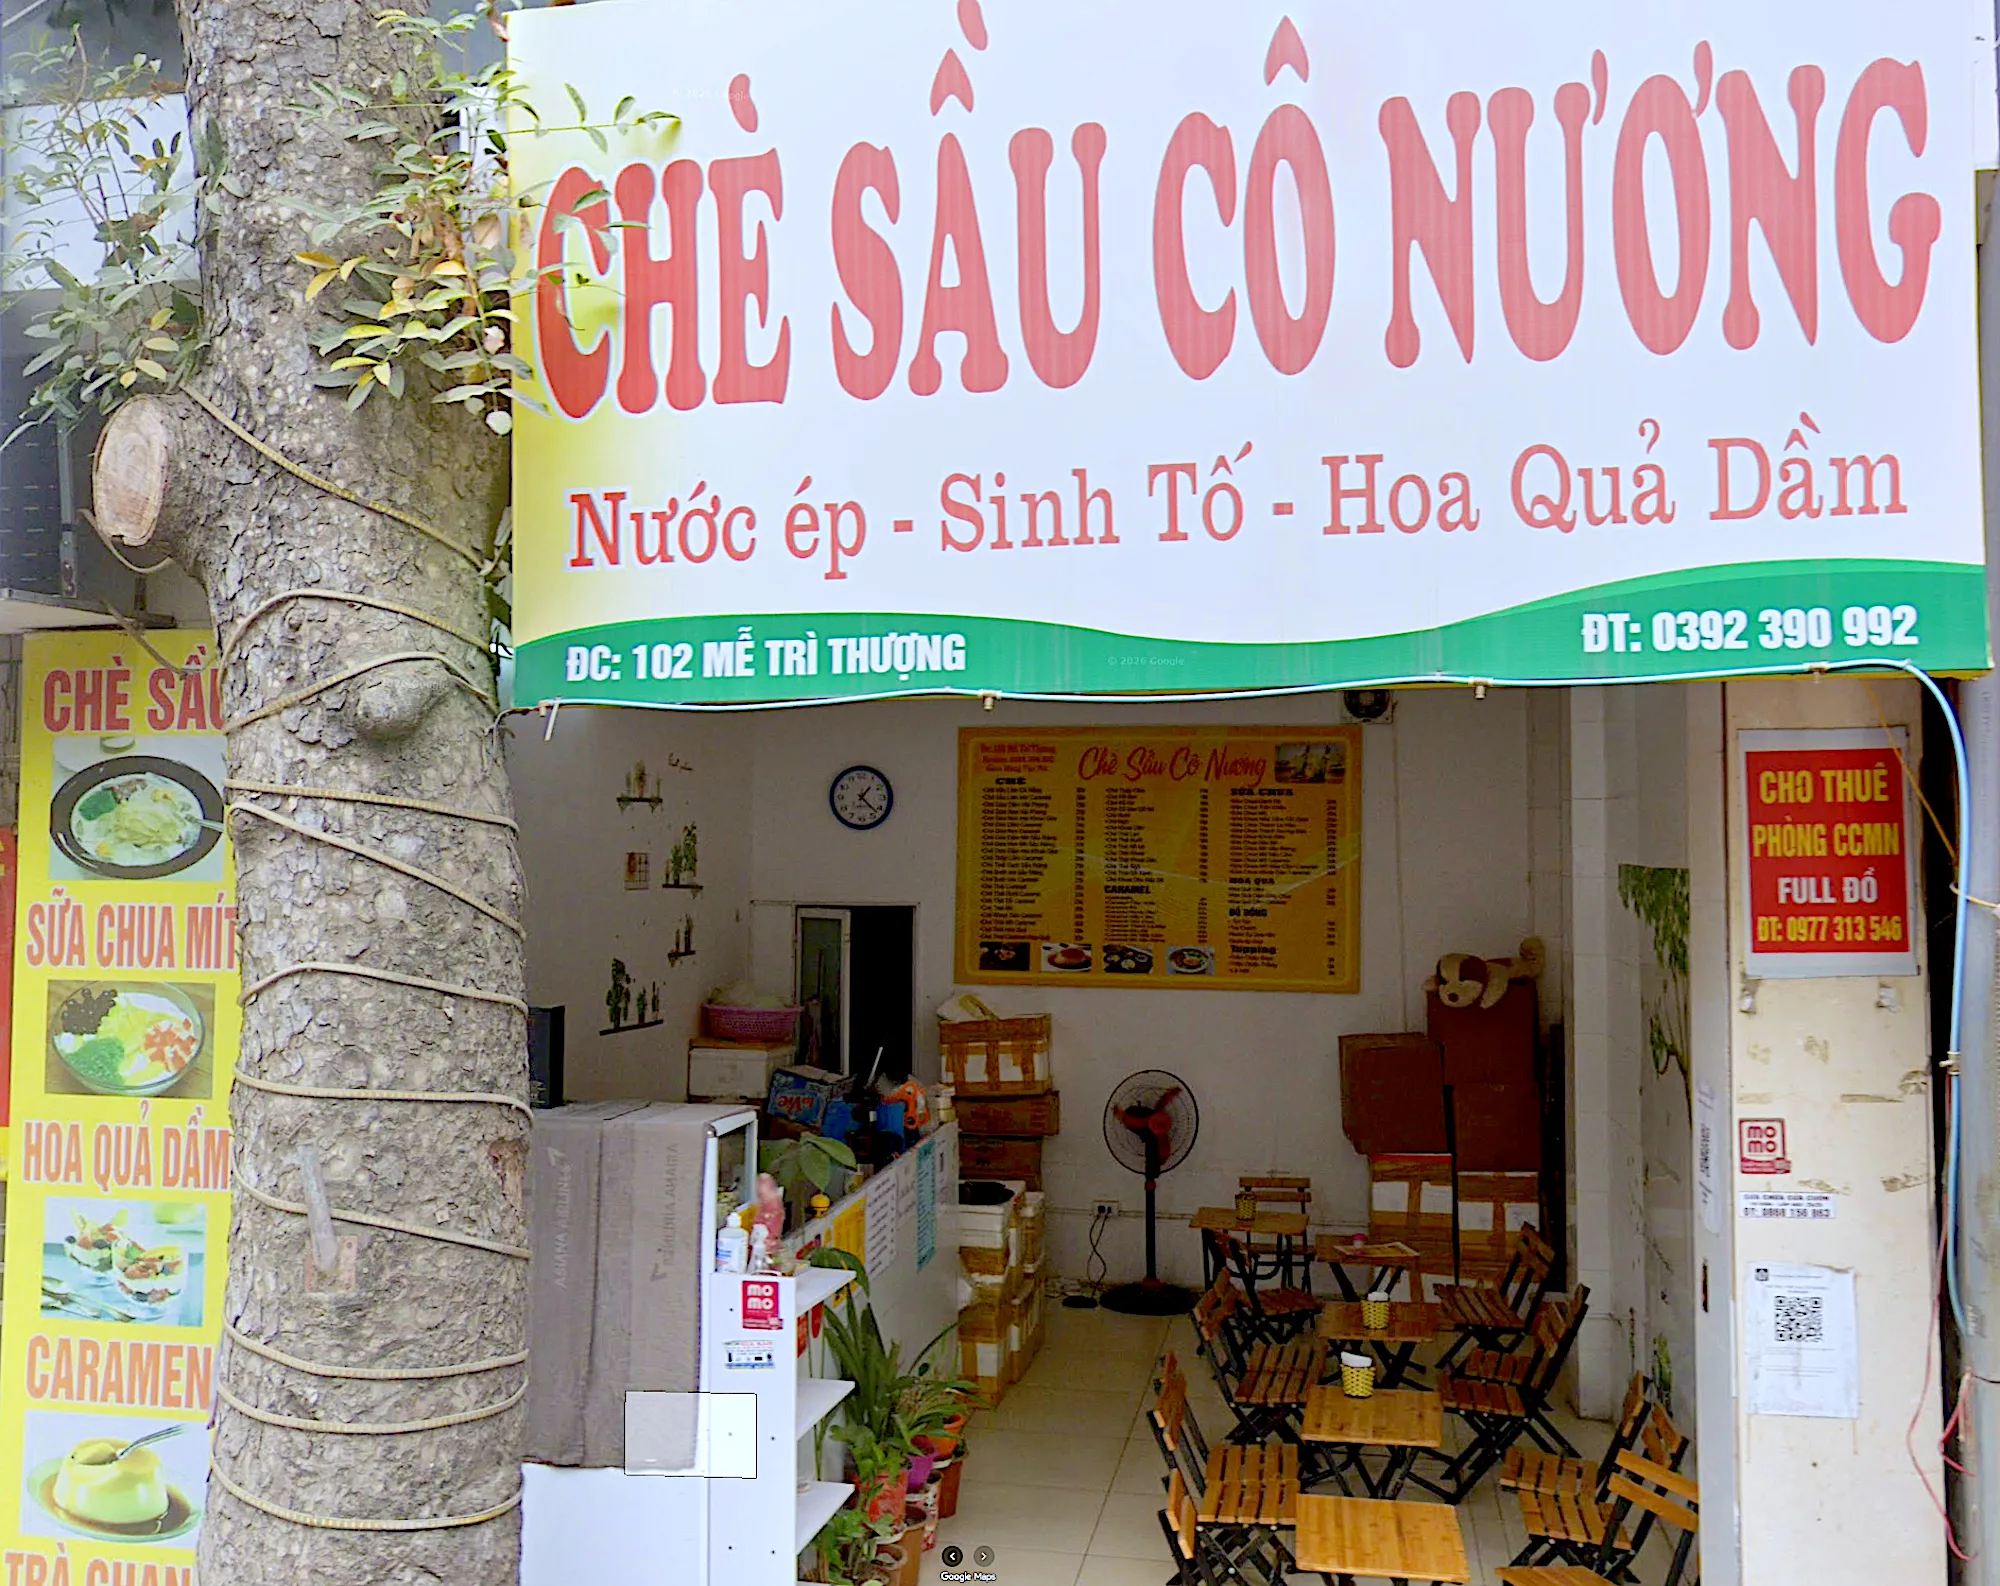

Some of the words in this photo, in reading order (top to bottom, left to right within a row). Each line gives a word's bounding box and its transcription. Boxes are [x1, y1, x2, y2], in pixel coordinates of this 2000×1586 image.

[536, 73, 791, 420] CHÈ
[831, 0, 1108, 401] SẦU
[1153, 15, 1335, 380] CÔ
[1378, 40, 1942, 370] NƯƠNG
[569, 481, 757, 567] Nước
[784, 475, 866, 581] ép
[940, 468, 1120, 553] Sinh
[1147, 440, 1253, 542] Tố
[1321, 453, 1480, 536] Hoa
[1510, 417, 1676, 534] Quả
[1708, 411, 1908, 521] Dầm
[1581, 612, 1642, 653] ĐT:
[1652, 609, 1749, 652] 0392
[1758, 607, 1832, 649] 390
[1843, 605, 1919, 647] 992
[566, 645, 621, 682] ĐC:
[632, 643, 693, 680] 102
[702, 626, 755, 678] MỄ
[765, 630, 818, 676] TRÌ
[830, 633, 966, 682] THƯỢNG
[44, 656, 131, 732] CHÈ
[1078, 746, 1119, 781] Chè
[1122, 746, 1166, 782] Sầu
[1168, 746, 1202, 781] Cô
[1204, 746, 1267, 788] Nương
[1759, 770, 1814, 804] CHO
[1820, 761, 1889, 803] THUÊ
[1752, 815, 1828, 858] PHÒNG
[1833, 822, 1900, 857] CCMN
[1777, 876, 1838, 905] FULL
[27, 888, 86, 967] SỮA
[97, 904, 176, 969] CHUA
[186, 892, 239, 969] MÍT
[1786, 916, 1829, 942] 0977
[1832, 916, 1867, 942] 313
[1870, 915, 1903, 941] 546
[23, 1121, 84, 1183] HOA
[94, 1099, 153, 1193] QUẢ
[162, 1106, 231, 1190] DẦM
[747, 1284, 774, 1297] mo
[747, 1297, 774, 1310] mo
[26, 1334, 213, 1410] CARAMEN
